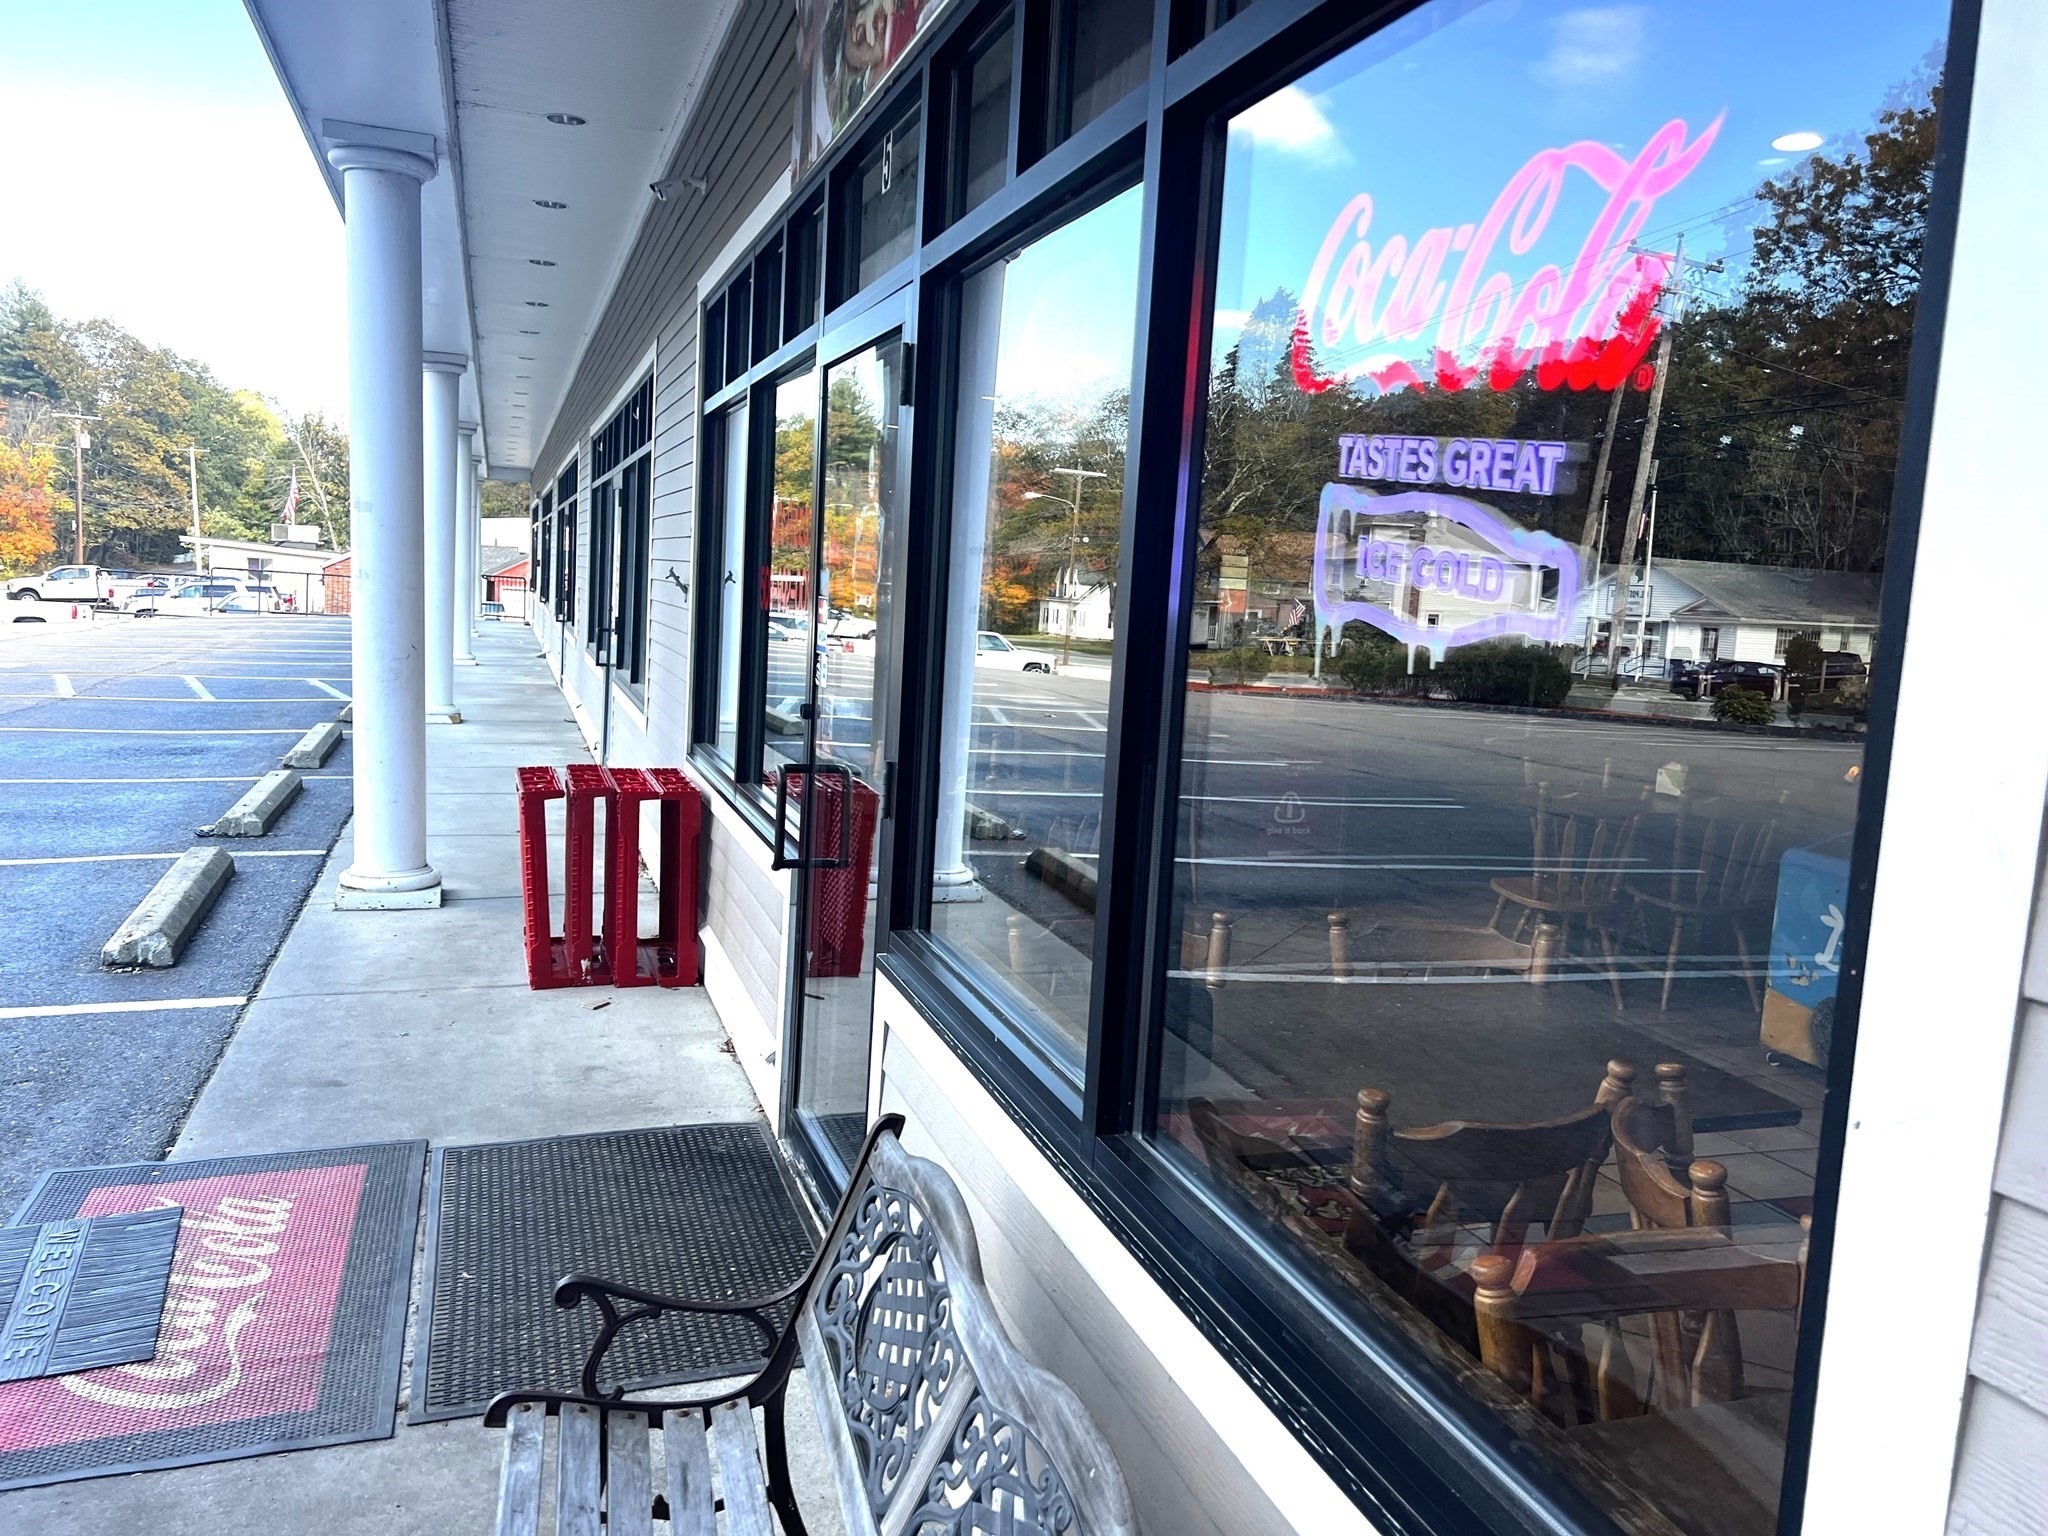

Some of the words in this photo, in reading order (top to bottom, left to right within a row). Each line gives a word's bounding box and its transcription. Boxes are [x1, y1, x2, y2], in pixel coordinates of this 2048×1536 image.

[1292, 106, 1728, 393] Coca-Cola
[1338, 434, 1437, 484] TASTES
[1443, 438, 1567, 496] GREAT
[1355, 535, 1405, 585] ICE
[1410, 545, 1506, 603] COLD
[3, 1229, 81, 1362] WELCOME
